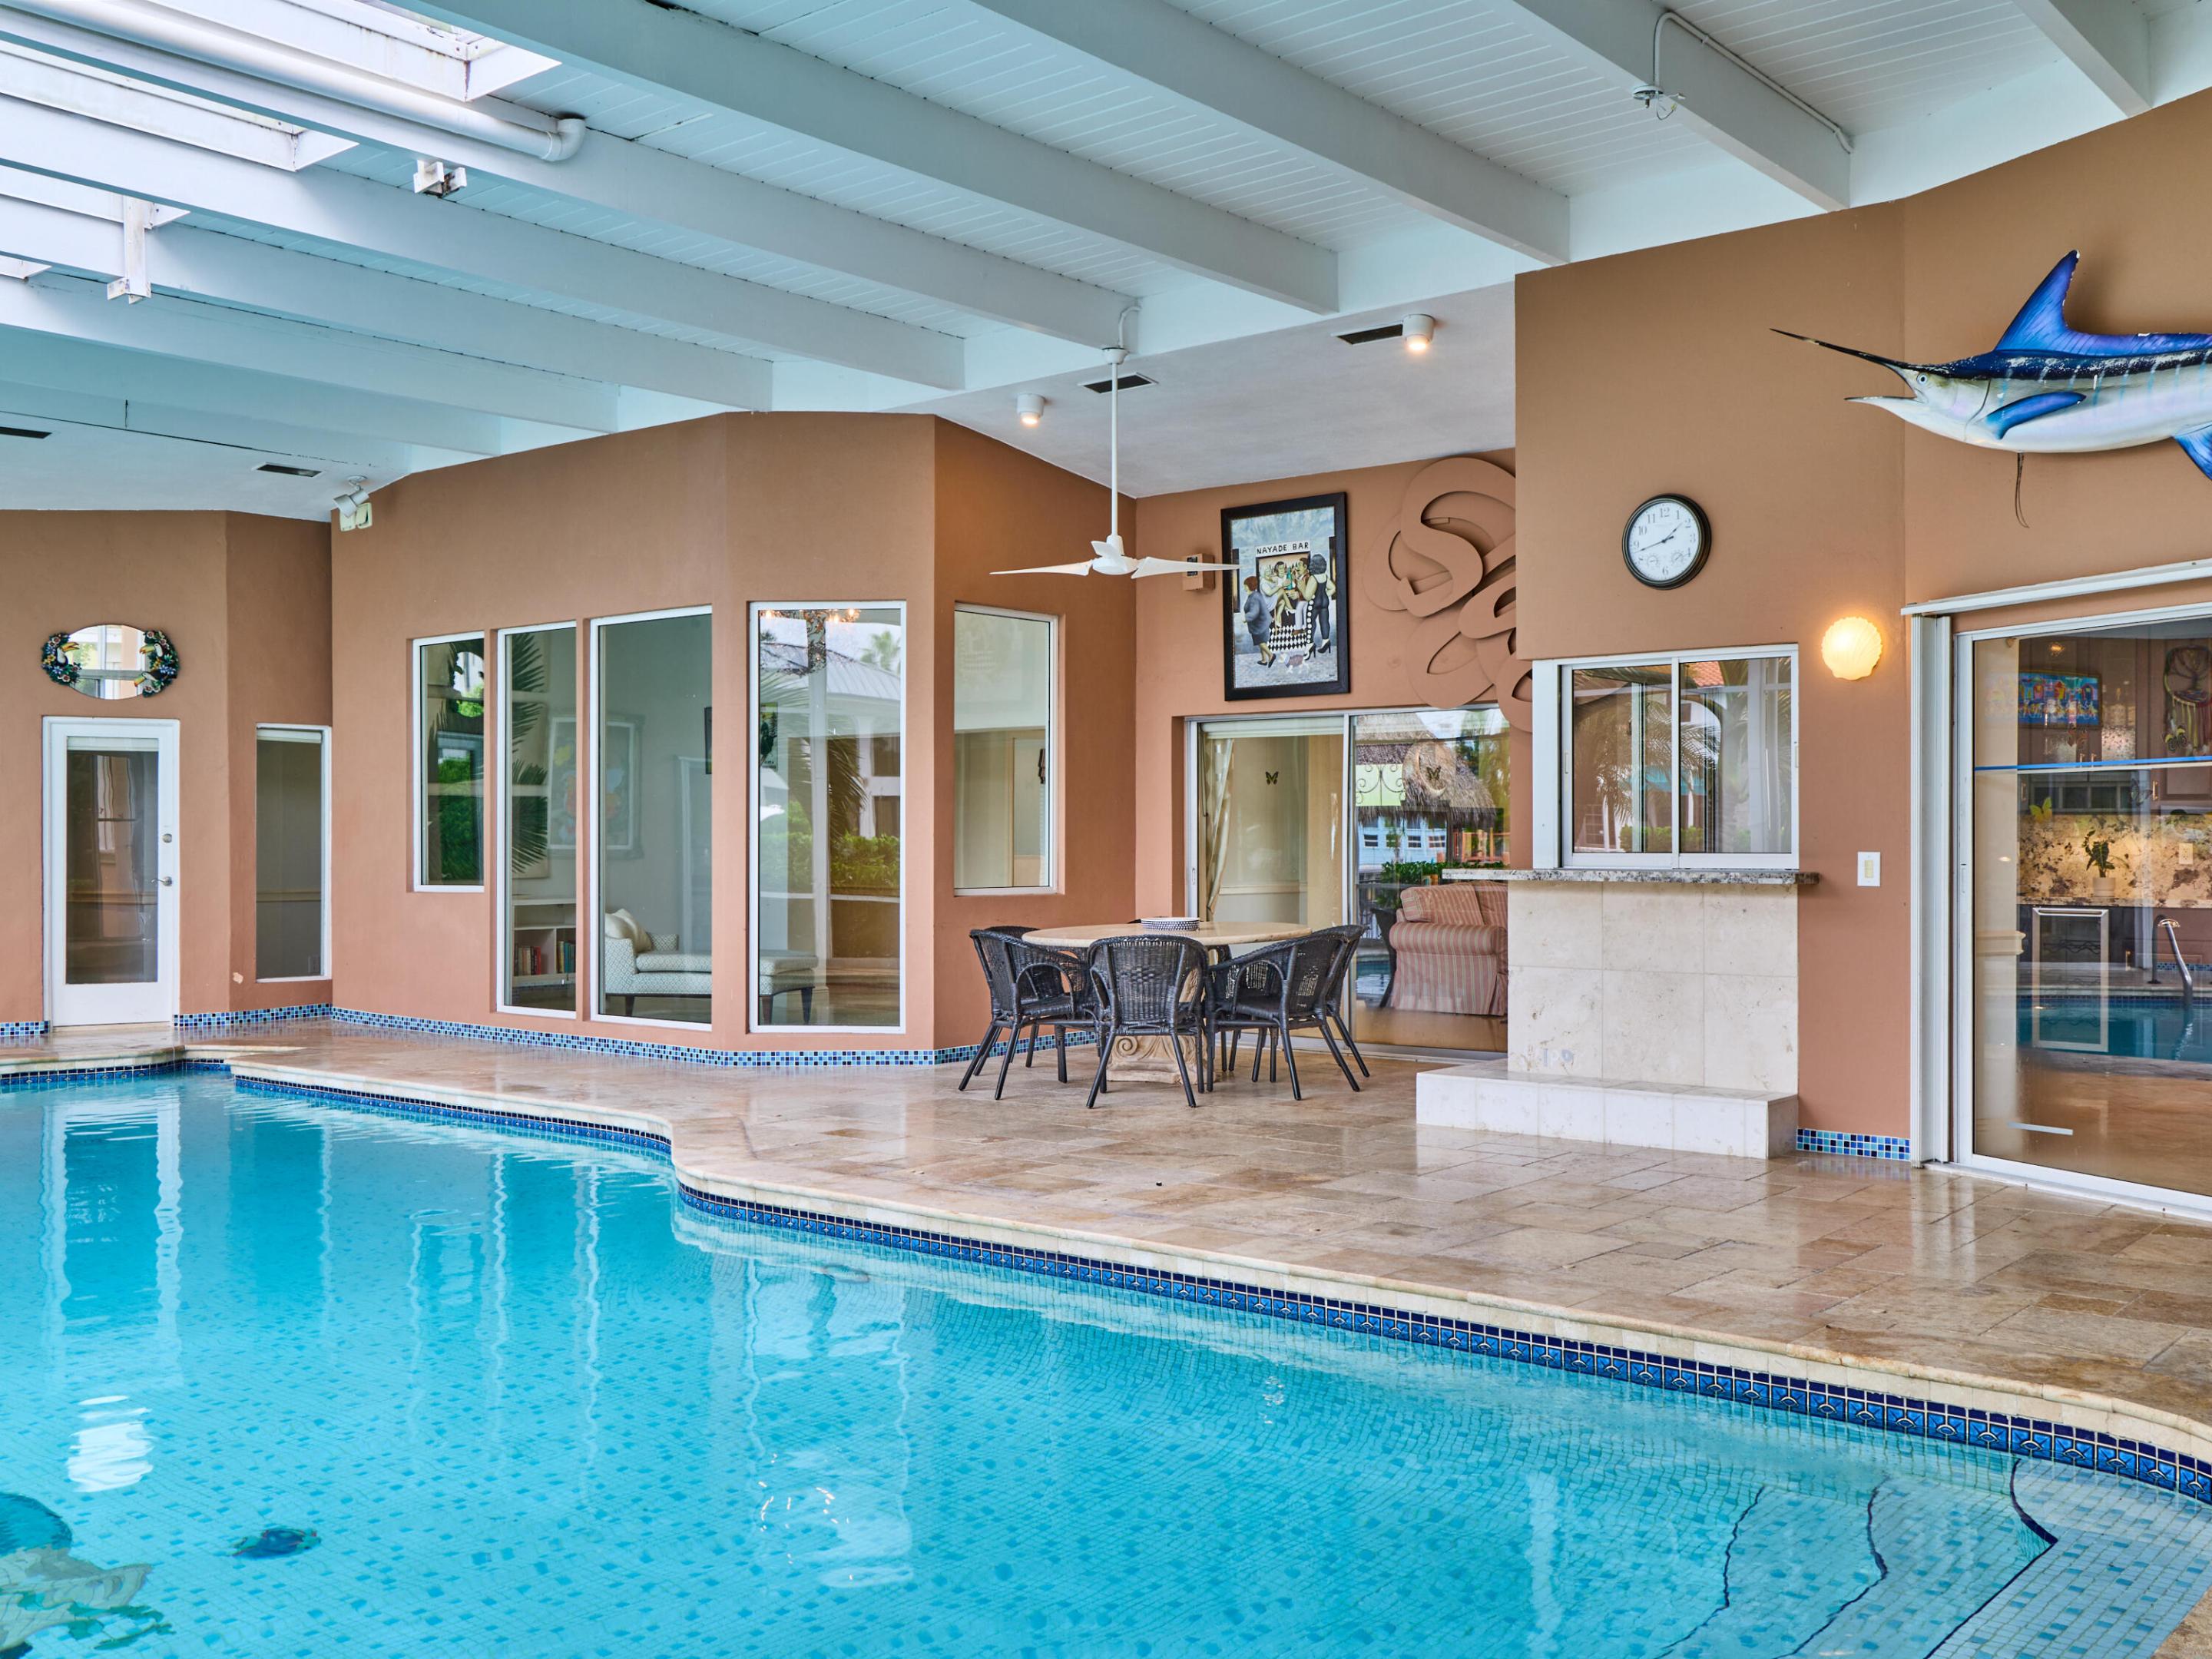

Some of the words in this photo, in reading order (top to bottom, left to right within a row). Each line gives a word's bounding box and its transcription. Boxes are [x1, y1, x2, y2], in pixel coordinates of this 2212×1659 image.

[1660, 507, 1670, 518] 12
[1638, 525, 1647, 535] 10
[1257, 544, 1287, 555] NAYADE
[1293, 542, 1309, 551] BAR
